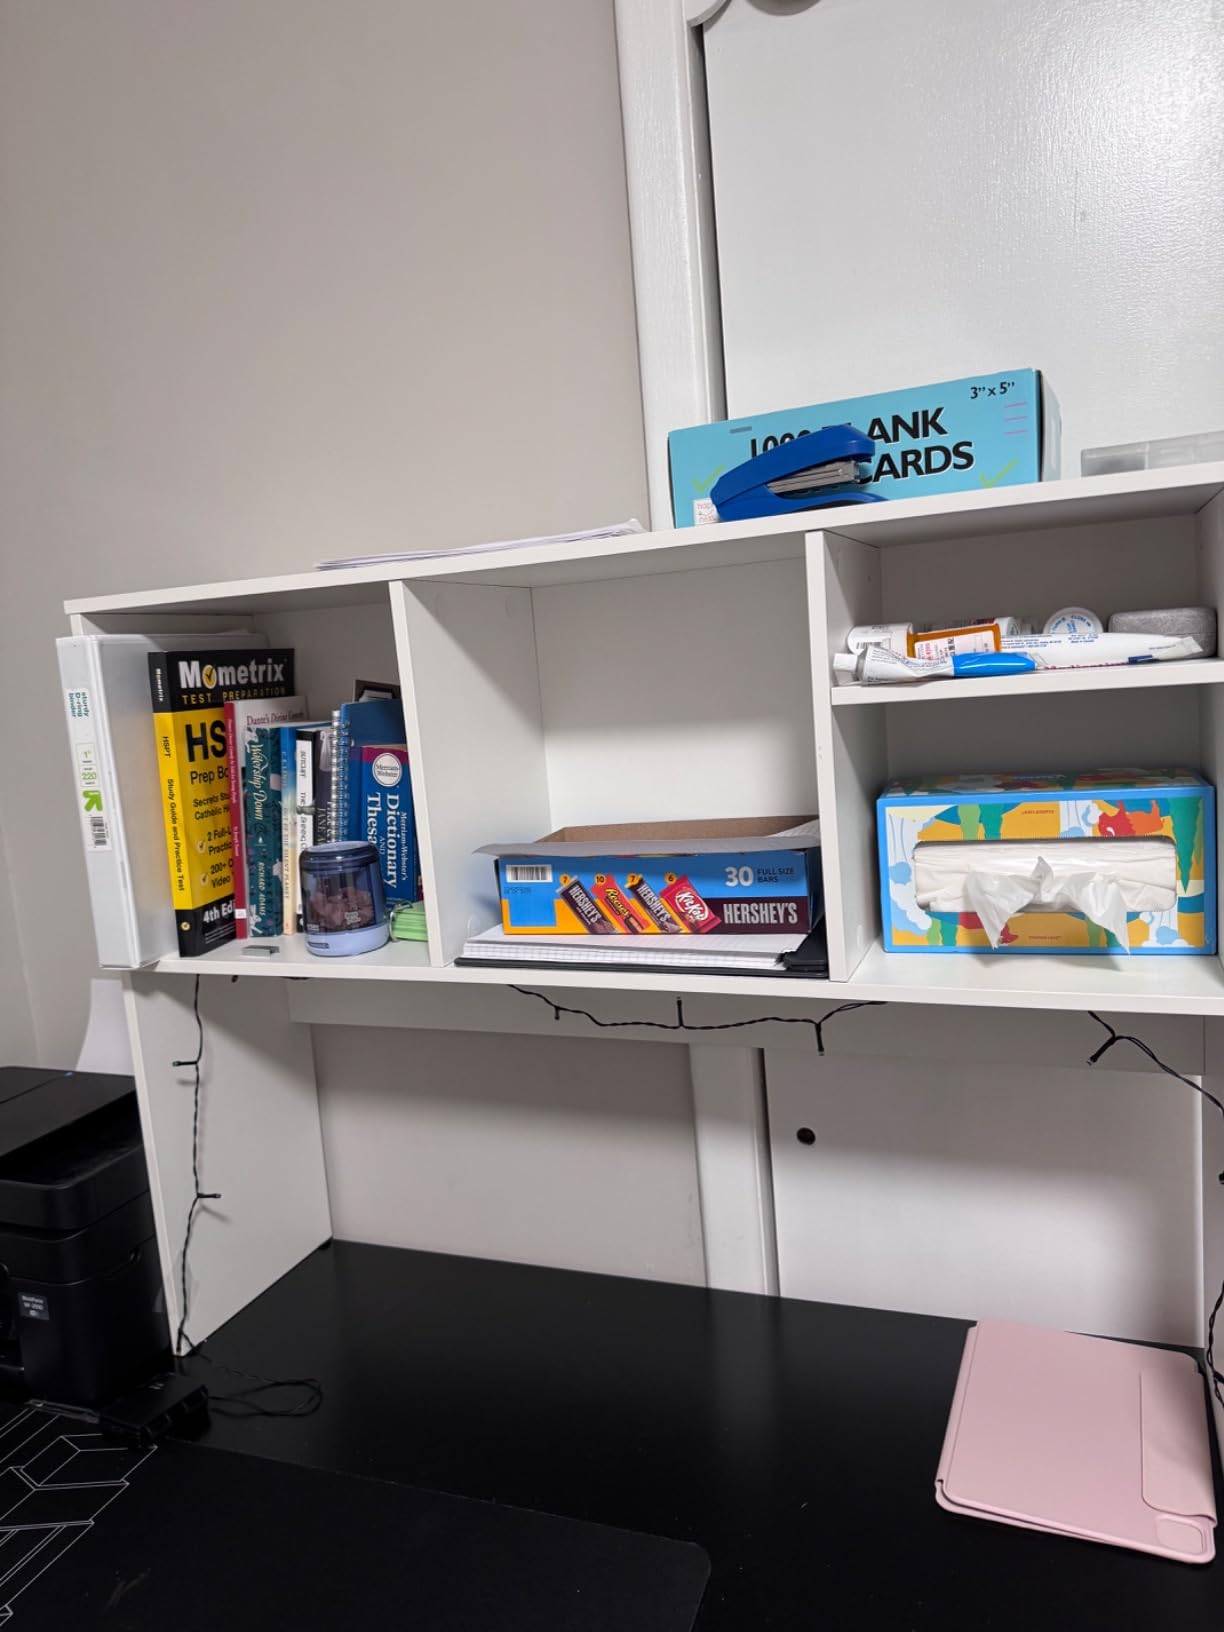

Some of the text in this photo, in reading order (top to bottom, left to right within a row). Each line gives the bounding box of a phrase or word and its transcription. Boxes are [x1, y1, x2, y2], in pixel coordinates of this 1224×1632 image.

[867, 406, 948, 444] ANK
[178, 658, 284, 689] Mometrix
[182, 687, 287, 705] TEST PREPARATION
[190, 770, 215, 785] Prep
[167, 778, 175, 801] Study
[169, 802, 178, 825] Guide
[195, 807, 222, 820] Catholic
[253, 790, 268, 819] Down
[383, 793, 400, 888] Dictionary
[174, 842, 183, 873] Practice
[212, 875, 230, 889] Video
[724, 865, 754, 888] 30
[757, 868, 777, 876] FULL
[203, 905, 220, 924] 4th
[568, 884, 601, 924] HERSHEY'S
[722, 902, 798, 925] HERSHEY'S
